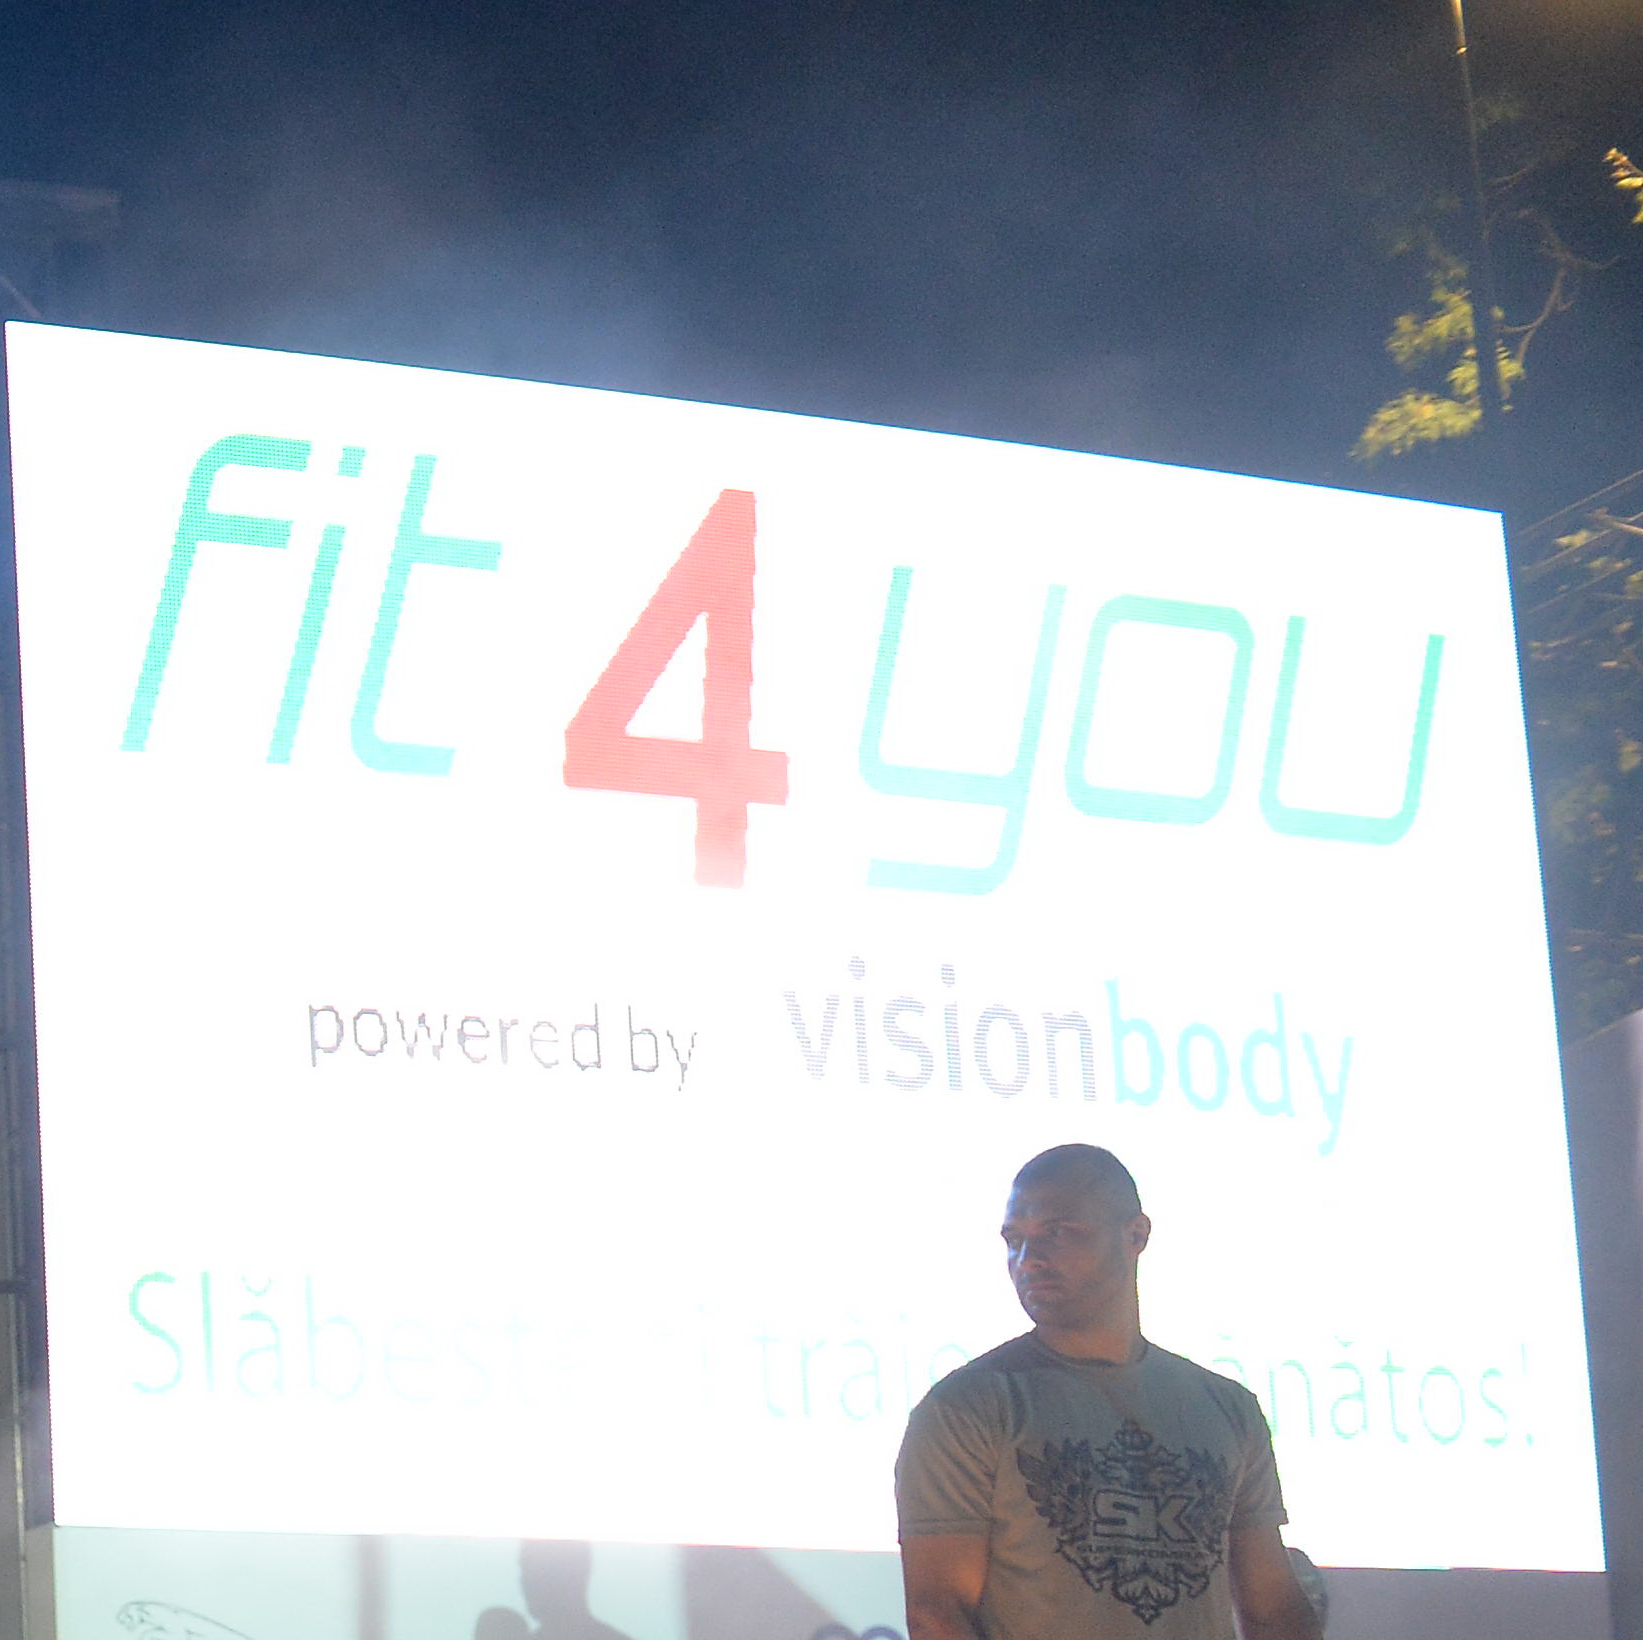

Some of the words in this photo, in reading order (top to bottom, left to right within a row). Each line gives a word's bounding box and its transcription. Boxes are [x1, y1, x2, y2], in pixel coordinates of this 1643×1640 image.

[119, 434, 503, 777] fit
[562, 487, 790, 889] 4
[858, 565, 1447, 897] you
[309, 1000, 604, 1072] powered
[627, 1003, 700, 1093] by
